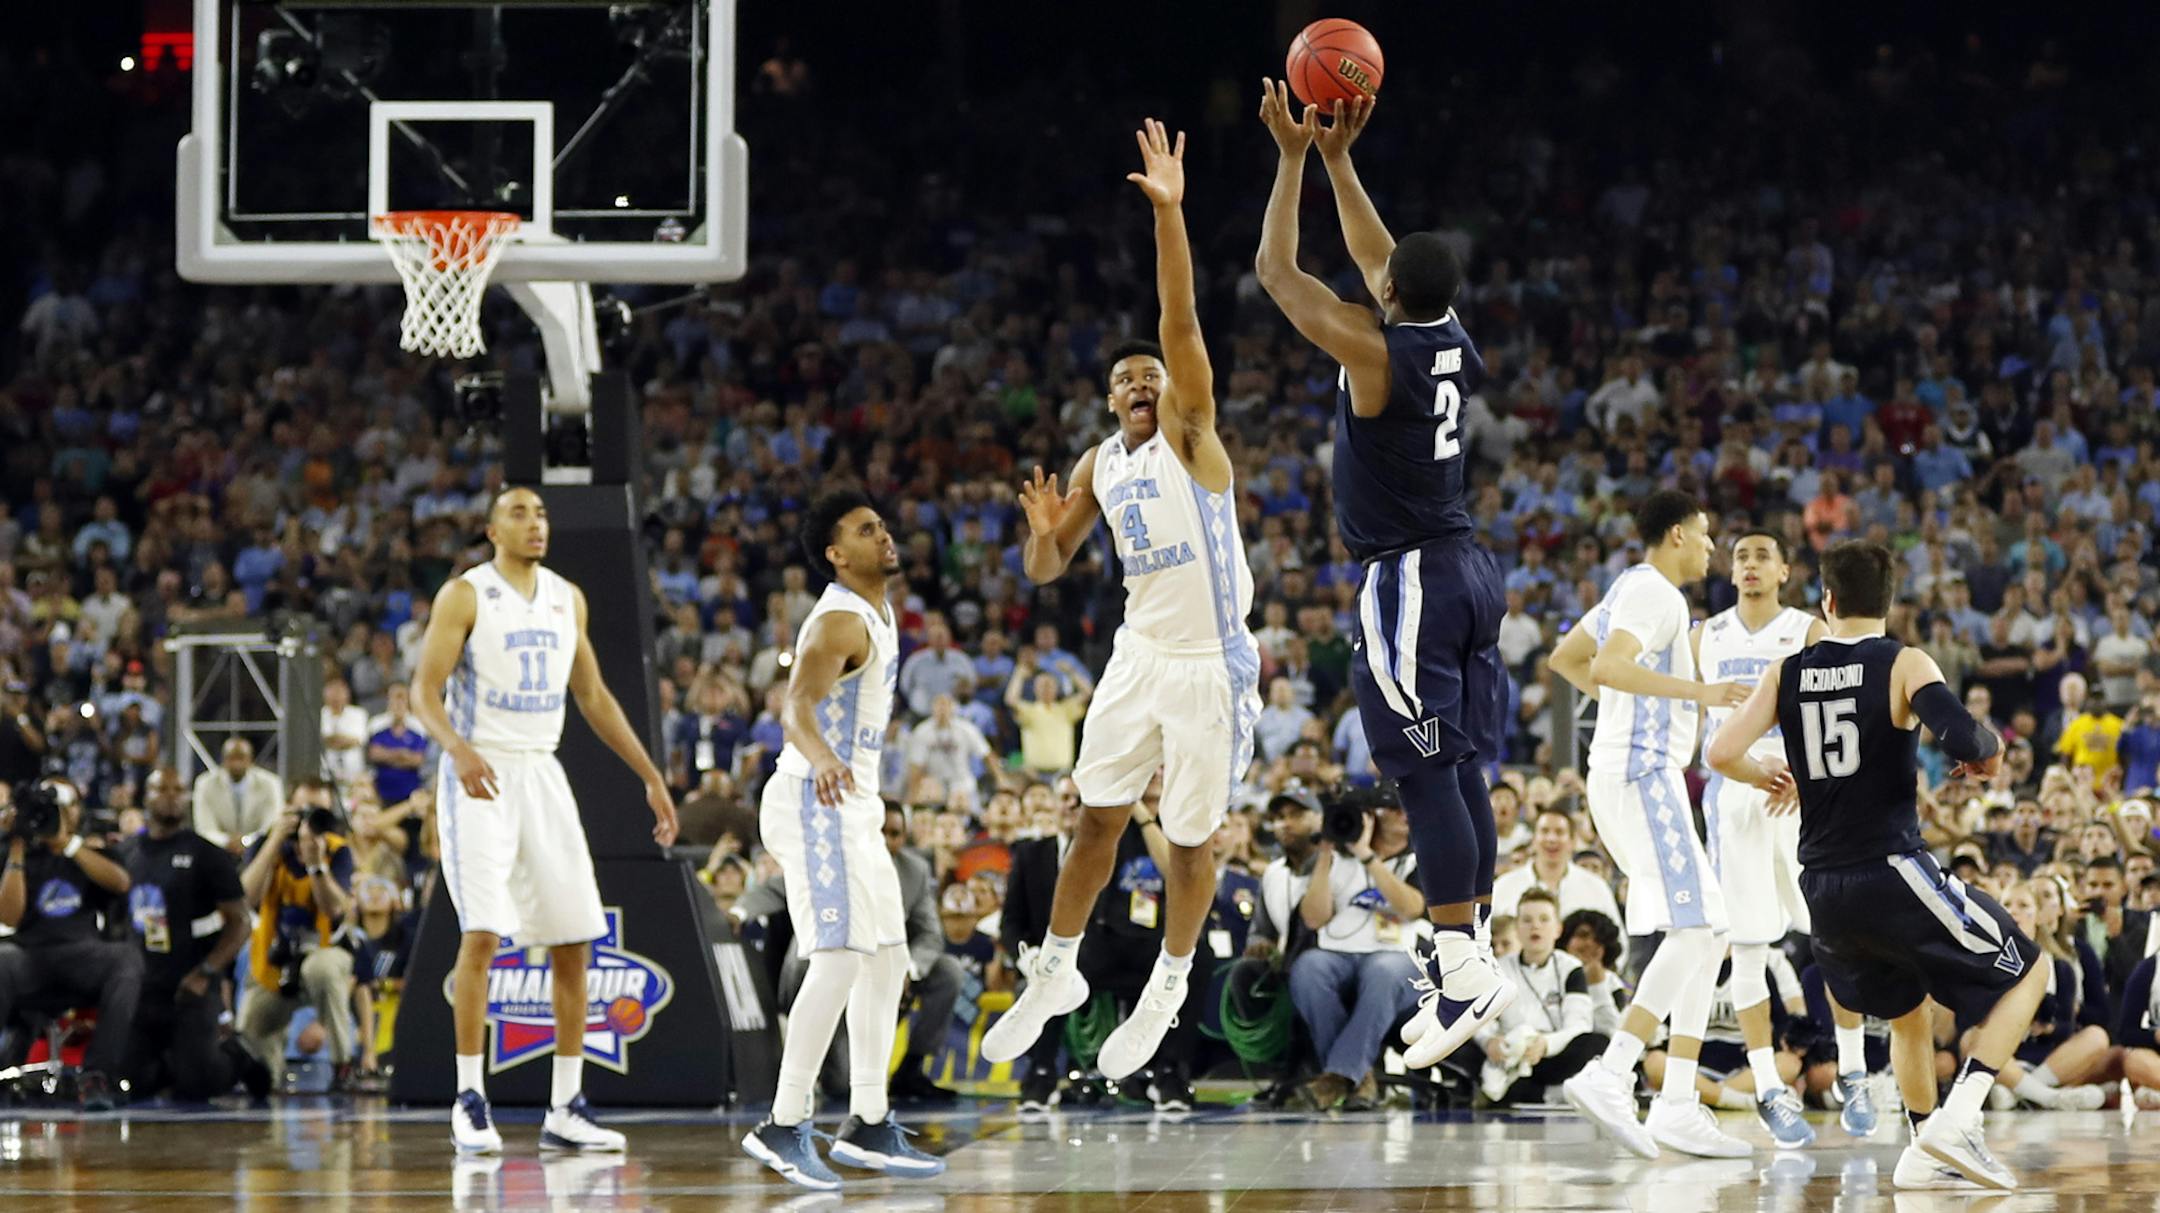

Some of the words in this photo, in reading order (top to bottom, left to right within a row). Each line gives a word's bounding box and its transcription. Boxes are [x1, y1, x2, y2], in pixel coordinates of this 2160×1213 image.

[1433, 379, 1461, 461] 2
[1120, 503, 1152, 551] 4
[518, 650, 549, 692] 11
[1717, 657, 1773, 679] NORT
[1799, 697, 1861, 781] 15
[586, 967, 648, 1004] OUR
